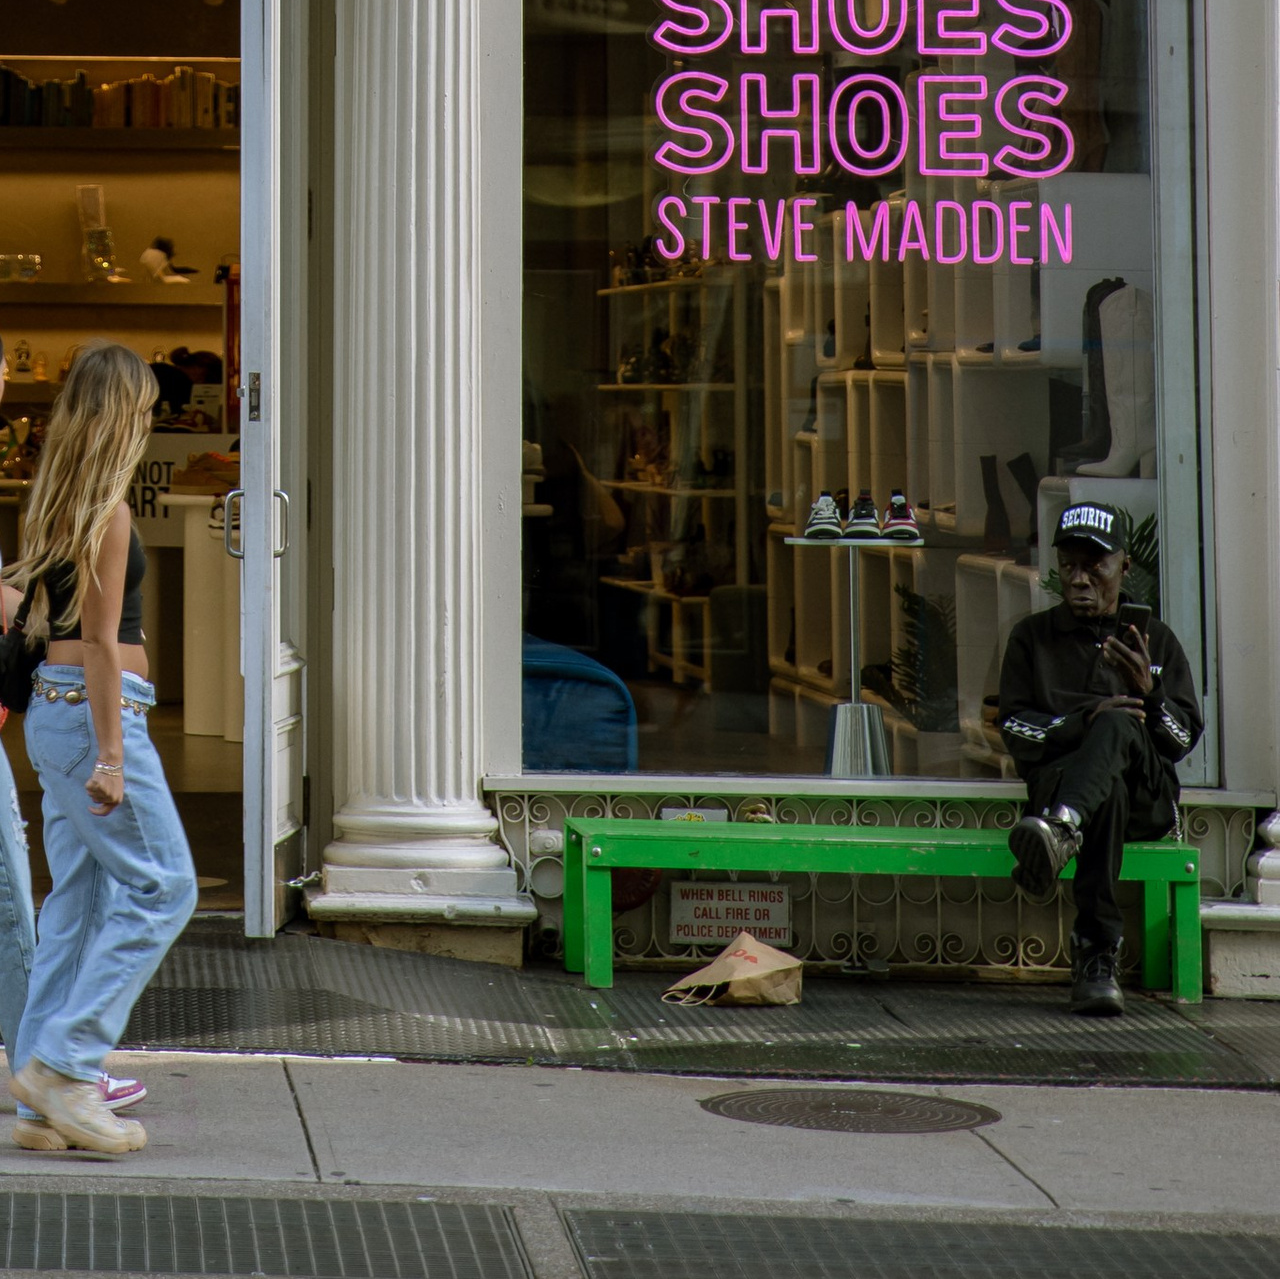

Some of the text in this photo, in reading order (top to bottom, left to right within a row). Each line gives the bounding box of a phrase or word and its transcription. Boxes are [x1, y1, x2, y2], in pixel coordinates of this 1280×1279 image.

[654, 71, 1076, 179] SHOES
[655, 195, 1074, 267] STEVE MADDEN
[1060, 505, 1114, 534] SECURITY
[680, 888, 784, 904] WHEN BELL RINGS
[693, 906, 770, 921] CALL FIRE OR
[676, 924, 713, 938] POLICE
